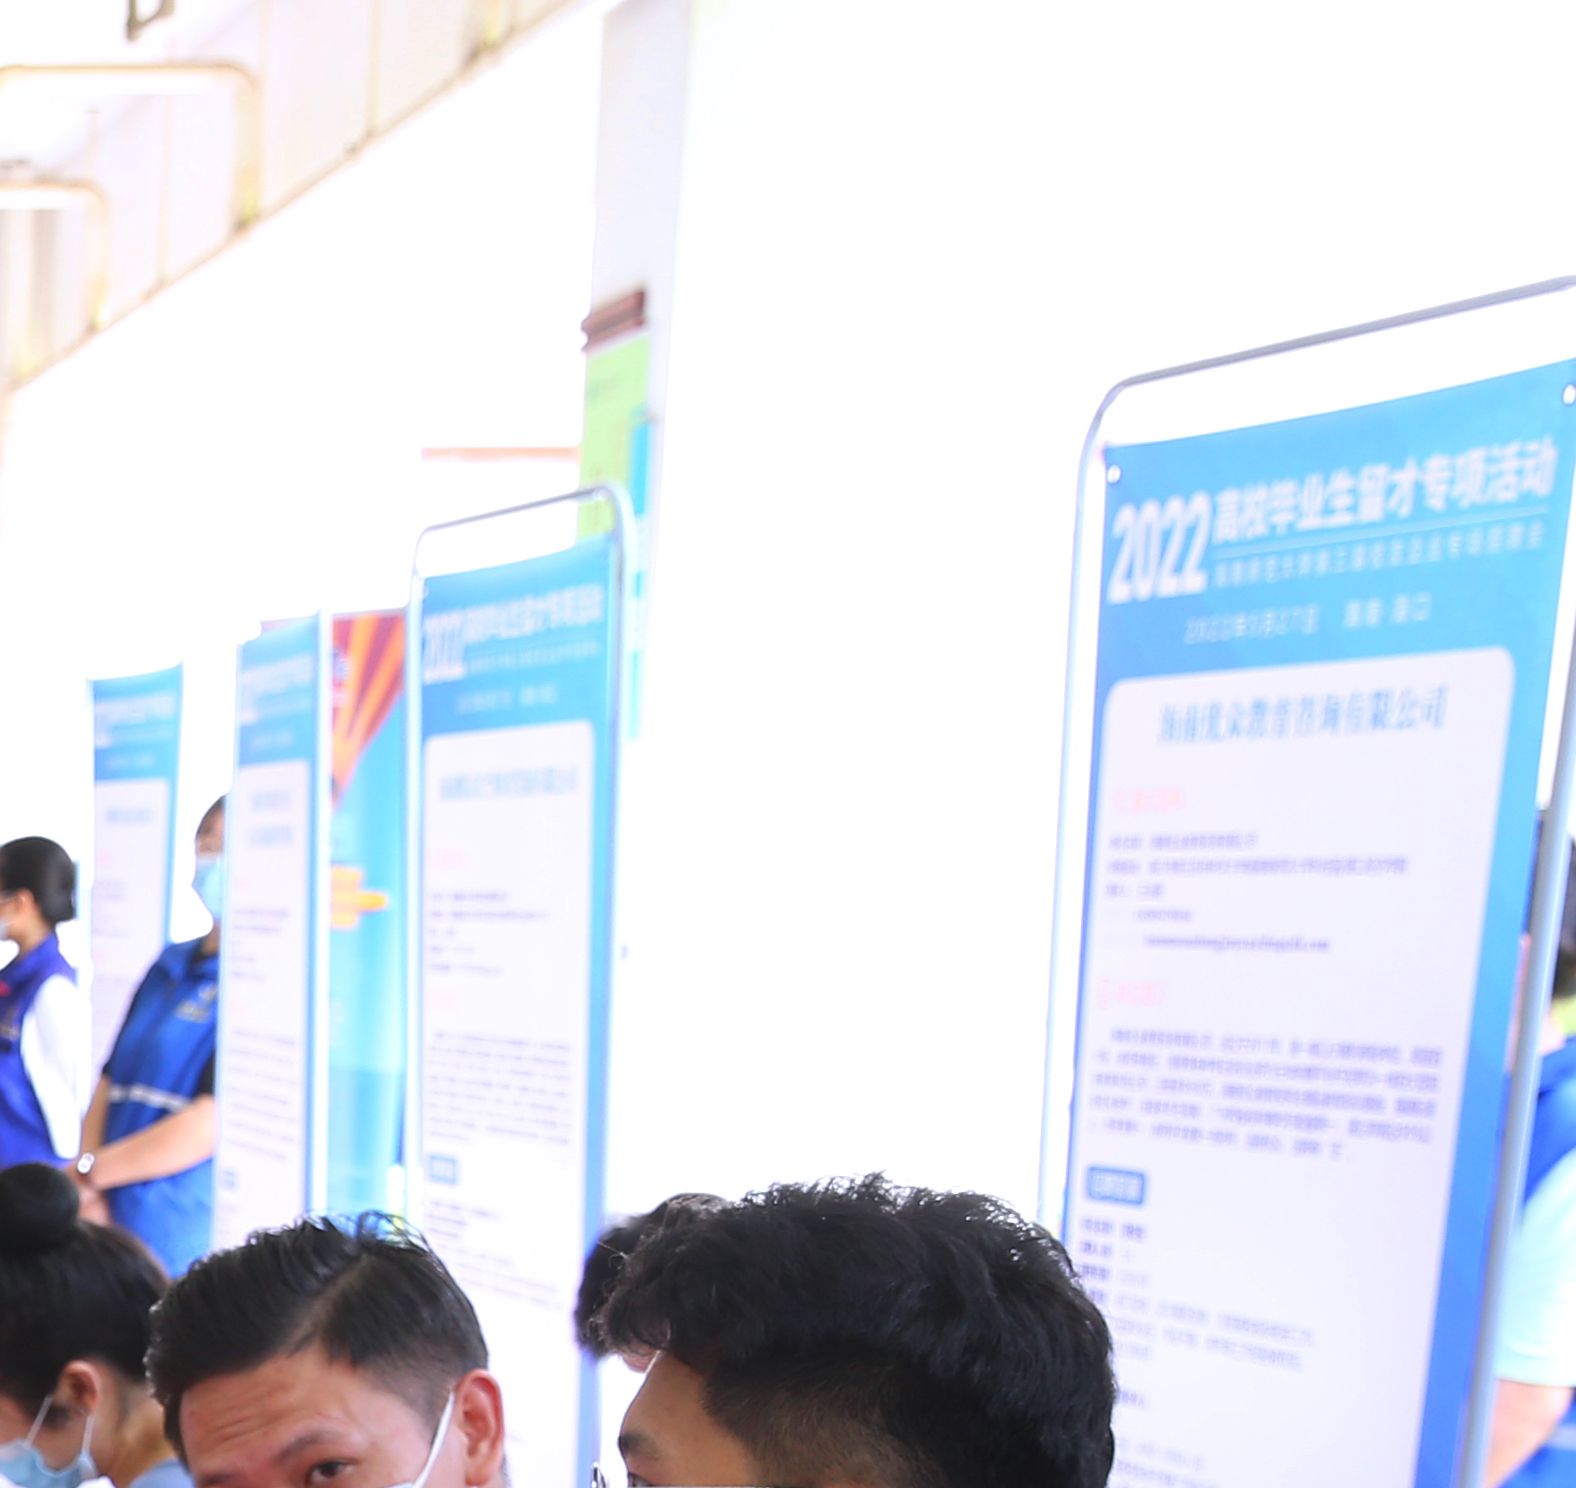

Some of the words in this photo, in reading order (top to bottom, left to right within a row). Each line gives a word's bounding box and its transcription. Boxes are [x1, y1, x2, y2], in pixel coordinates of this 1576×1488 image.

[1107, 491, 1212, 604] 2022
[1212, 435, 1558, 546] 高校毕业生留才专项活动
